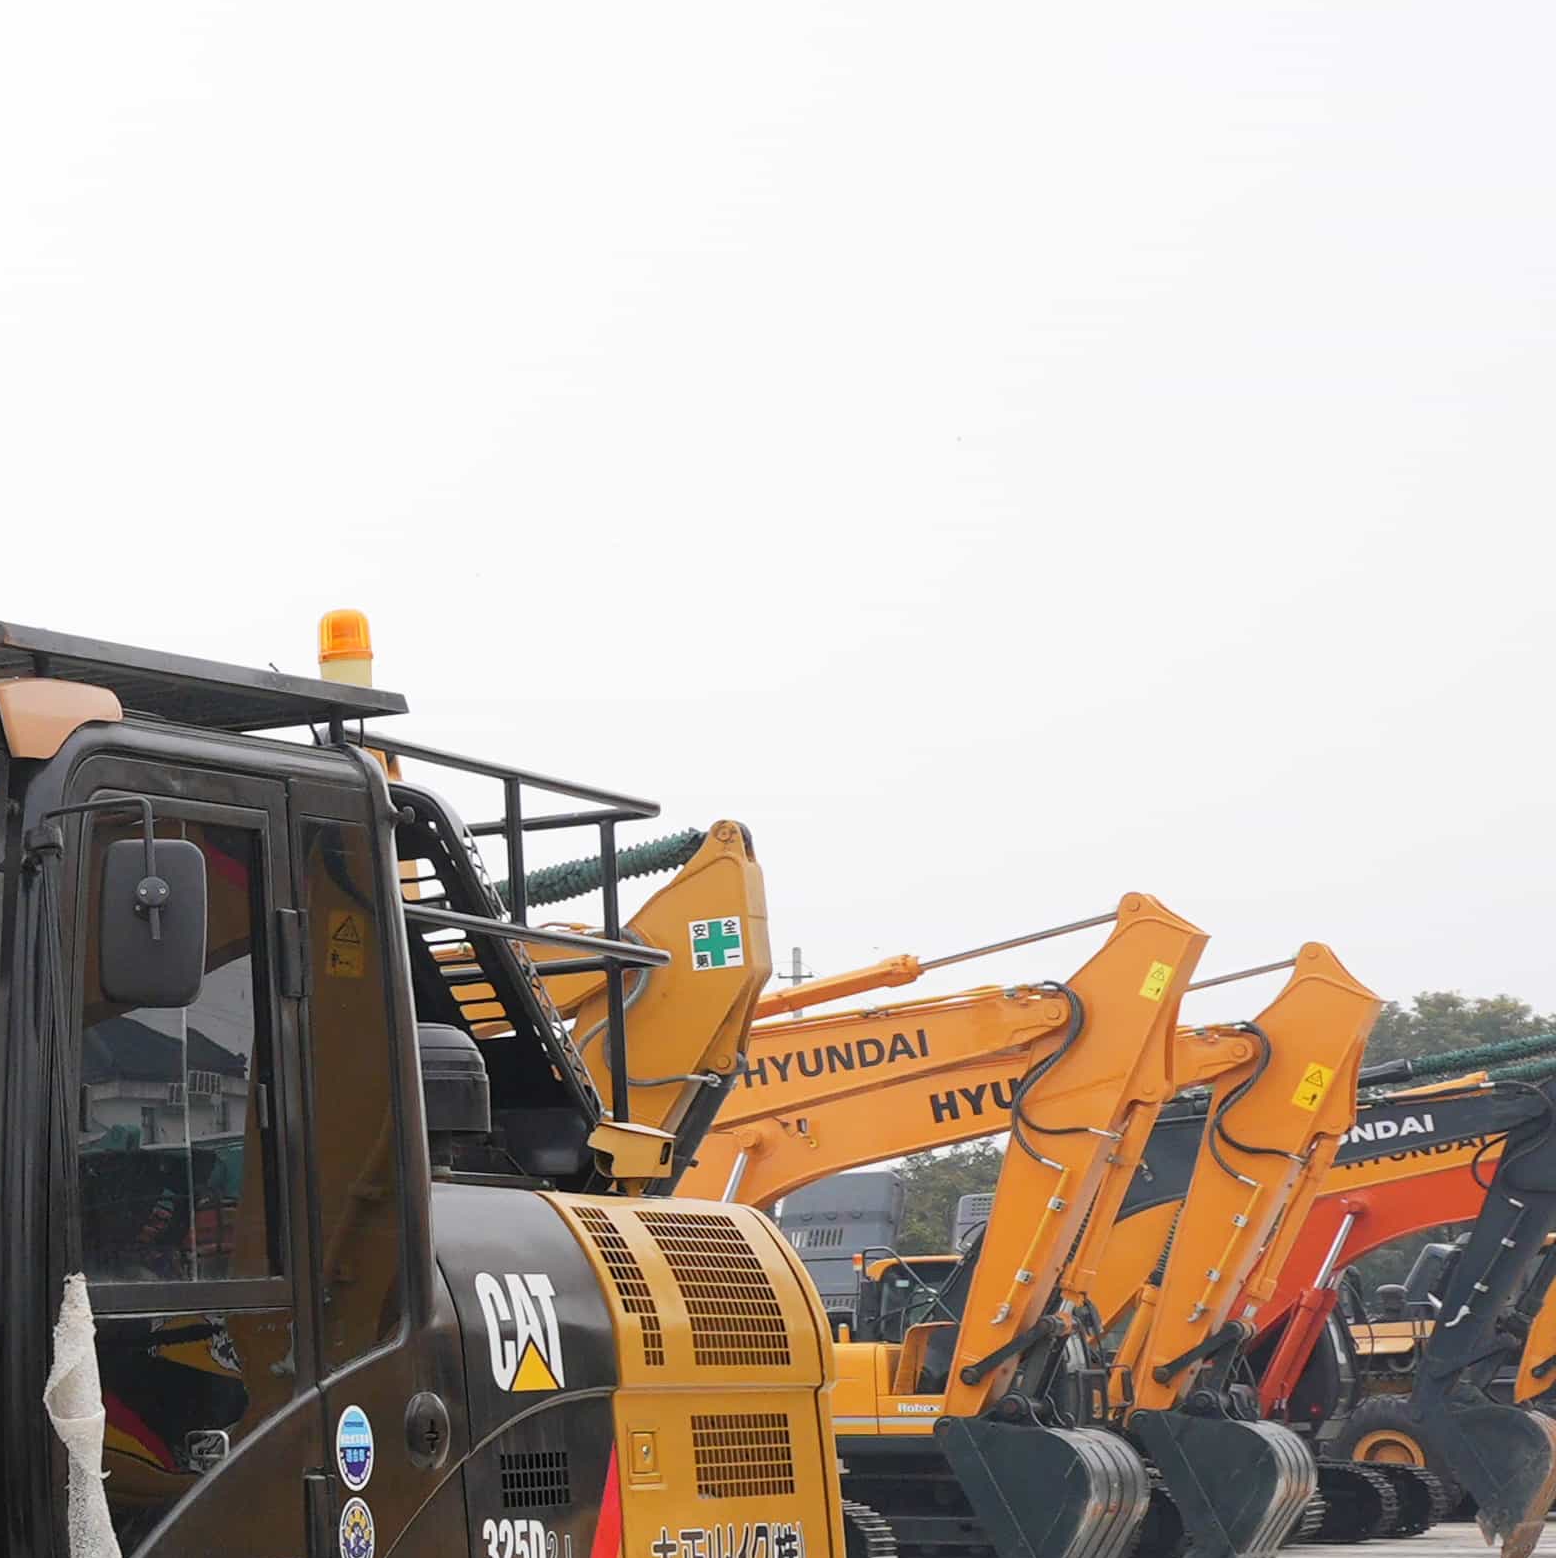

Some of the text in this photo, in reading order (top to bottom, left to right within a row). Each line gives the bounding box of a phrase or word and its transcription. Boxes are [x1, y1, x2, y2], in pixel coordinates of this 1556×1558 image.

[742, 1029, 930, 1088] HYUNDAI
[1339, 1114, 1435, 1145] NDAI
[475, 1272, 566, 1391] CAT
